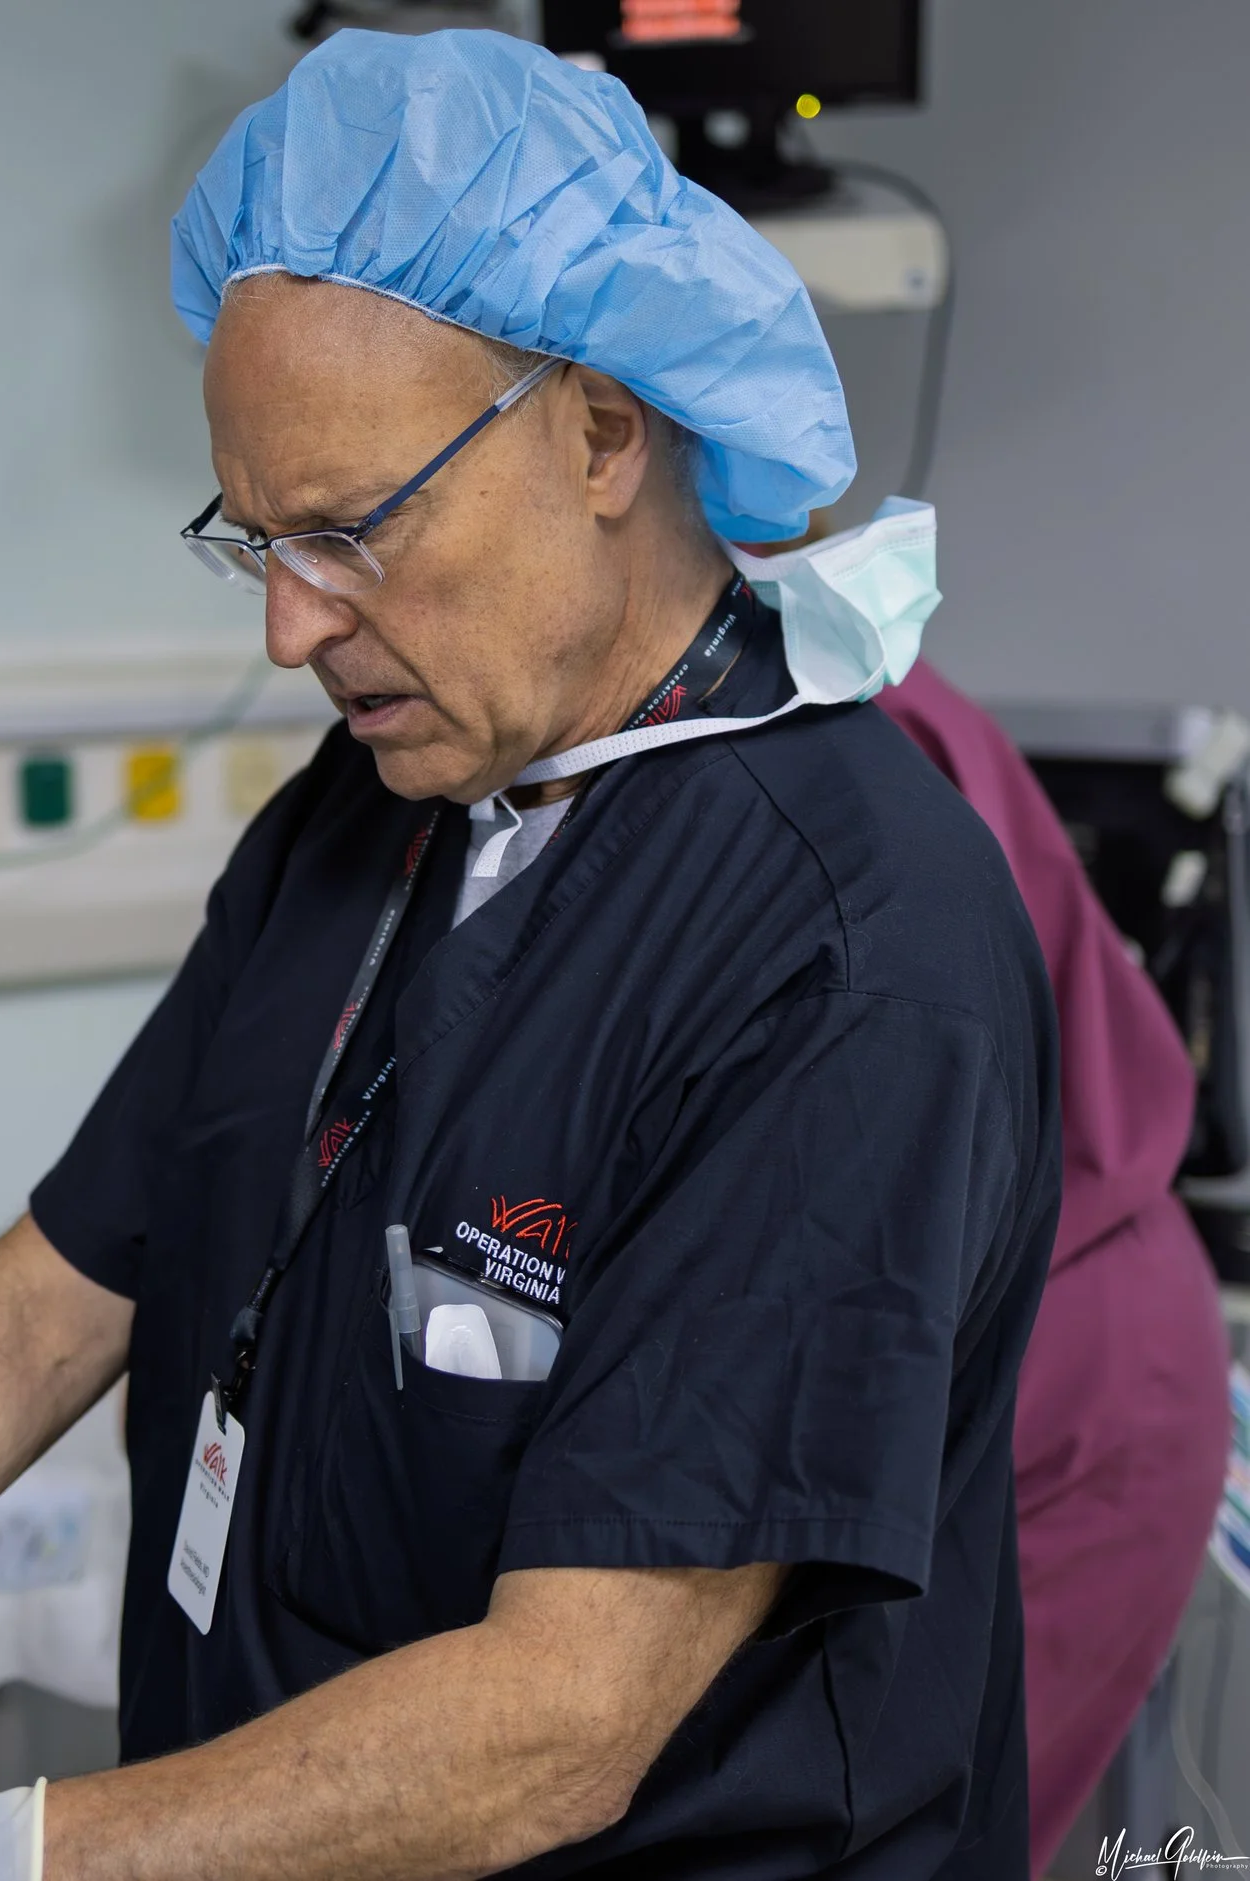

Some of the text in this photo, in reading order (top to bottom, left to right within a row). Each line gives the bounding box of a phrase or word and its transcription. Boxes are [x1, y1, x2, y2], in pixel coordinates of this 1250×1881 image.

[704, 613, 737, 657] Virginia
[647, 664, 689, 711] OPERATION
[455, 1221, 554, 1281] OPERATION
[484, 1257, 560, 1305] VIRGINIA
